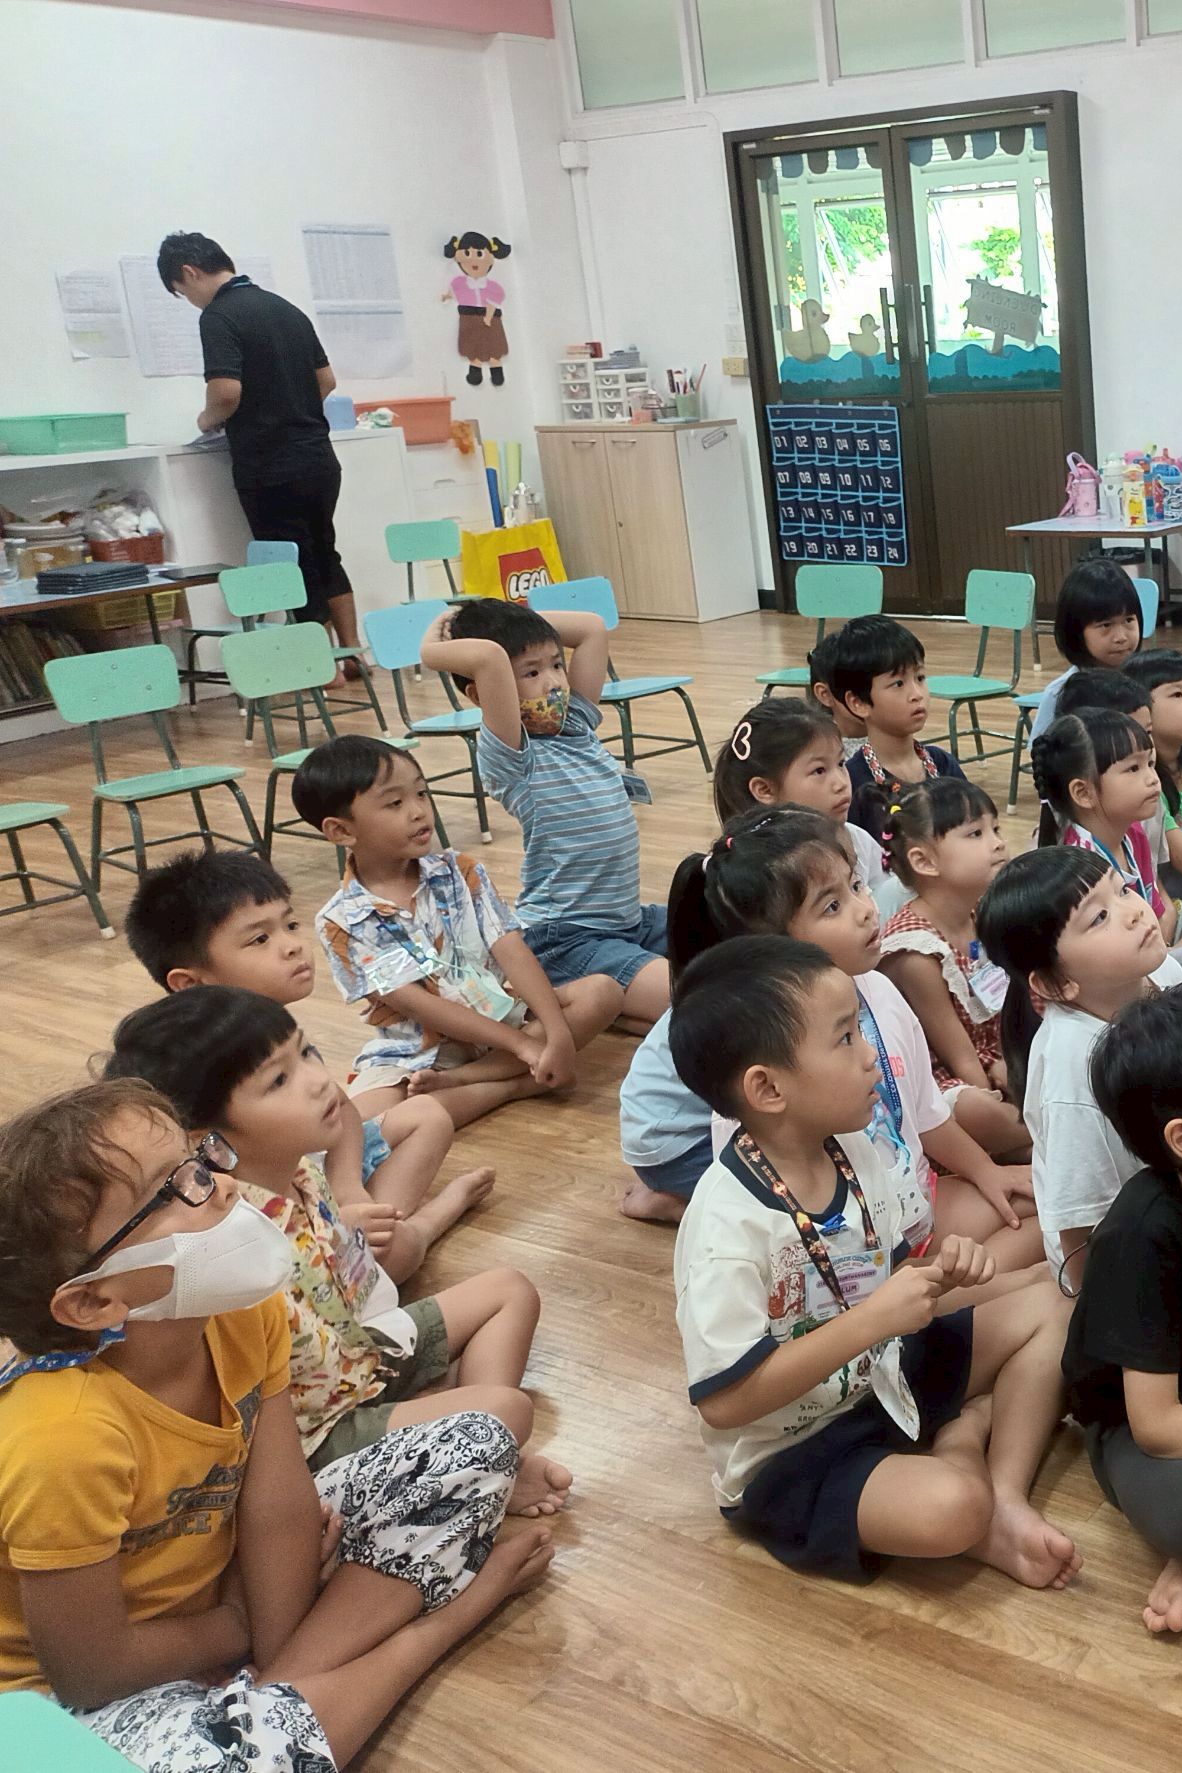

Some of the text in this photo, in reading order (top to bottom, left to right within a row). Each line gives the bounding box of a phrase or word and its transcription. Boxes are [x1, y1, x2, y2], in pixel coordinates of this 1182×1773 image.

[774, 435, 891, 451] 01 02 03 04 05 06
[777, 471, 893, 488] 07 08 09 10 11 12
[781, 506, 896, 524] 13 14 15 16 17 18
[784, 541, 899, 559] 19 20 21 22 23 24
